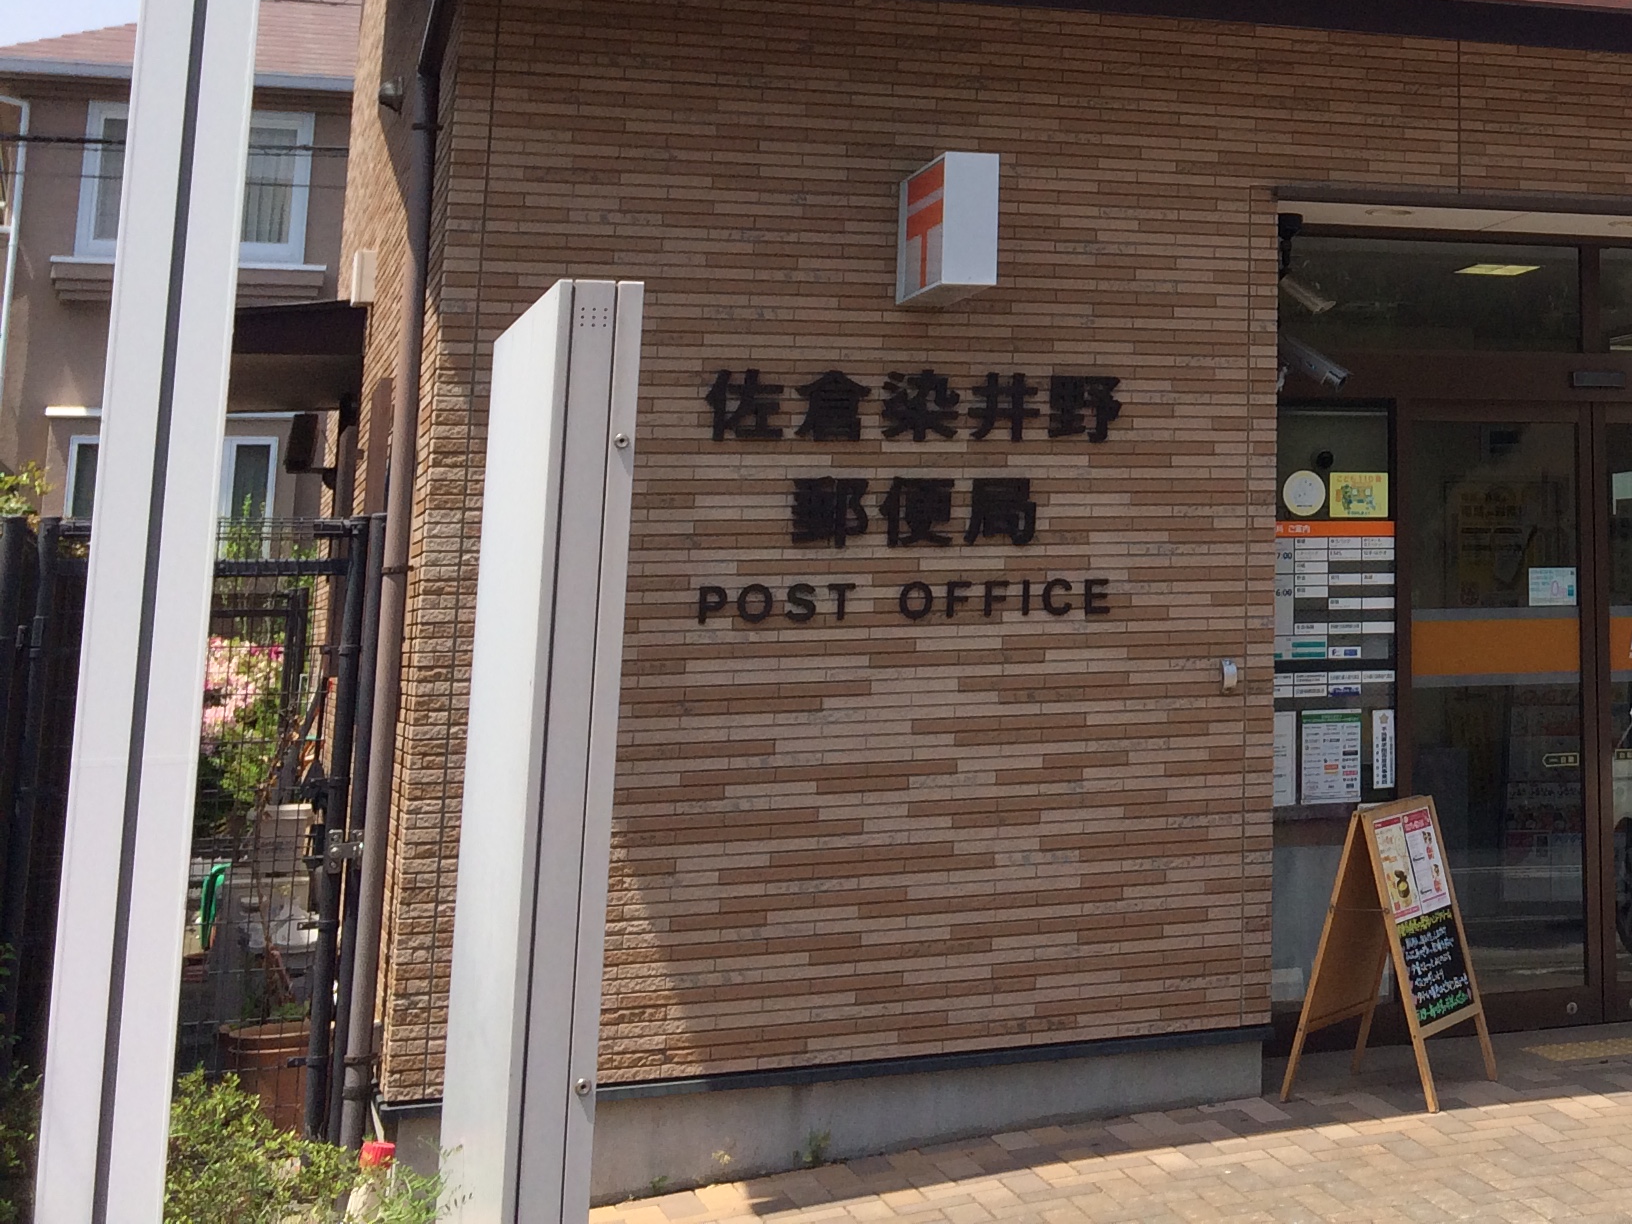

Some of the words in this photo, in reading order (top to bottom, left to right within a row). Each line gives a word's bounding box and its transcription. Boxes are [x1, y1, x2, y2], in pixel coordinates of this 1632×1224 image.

[705, 369, 1123, 444] 佐倉染井野
[790, 475, 1037, 548] 郵便局
[698, 582, 857, 625] POST
[899, 578, 1112, 621] OFFICE
